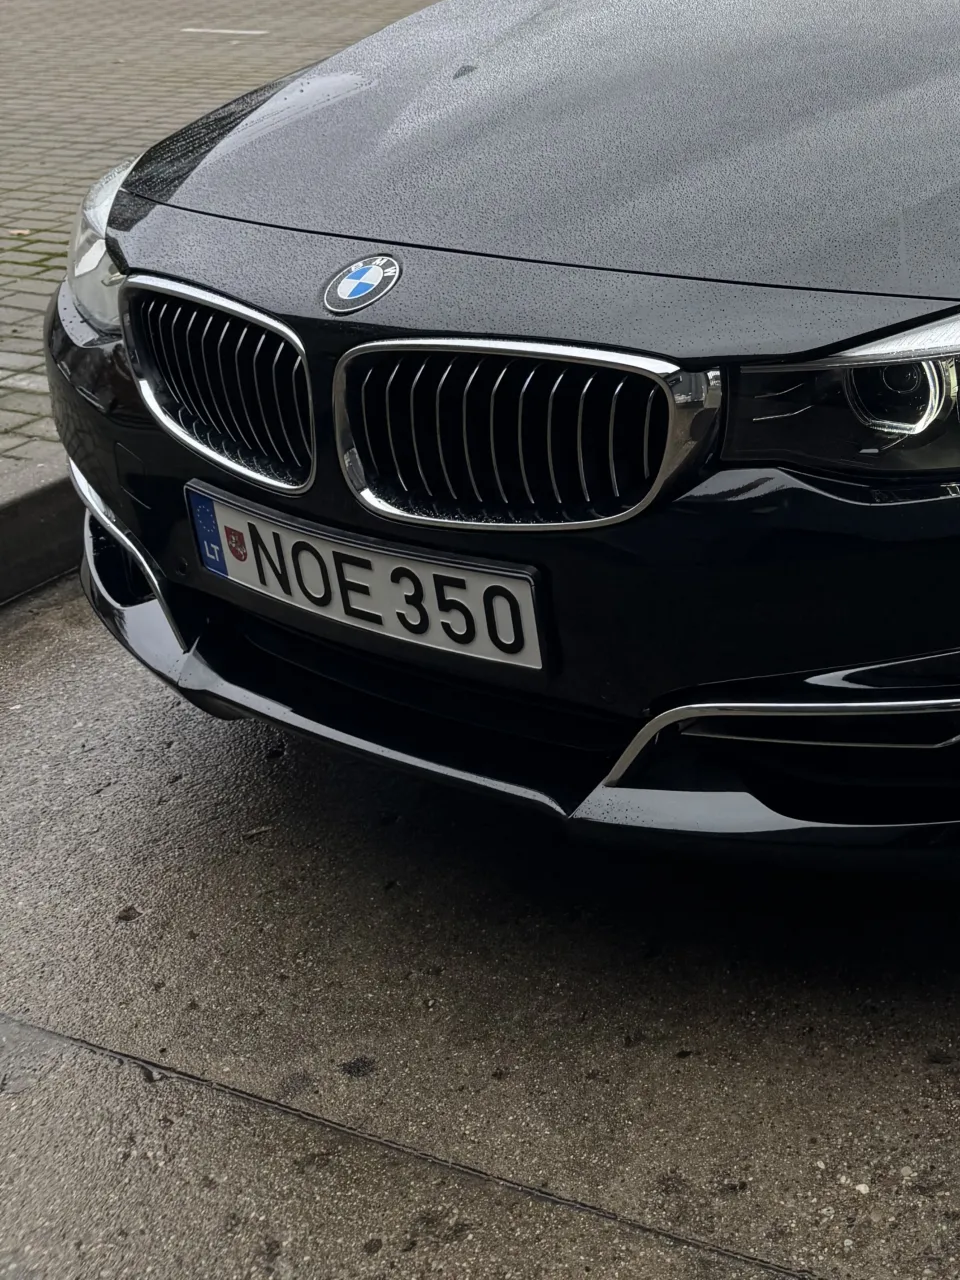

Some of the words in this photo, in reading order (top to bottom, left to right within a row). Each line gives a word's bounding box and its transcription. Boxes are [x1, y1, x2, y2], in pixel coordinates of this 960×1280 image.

[204, 542, 220, 562] LT
[247, 521, 383, 626] NOE
[390, 566, 525, 655] 350
